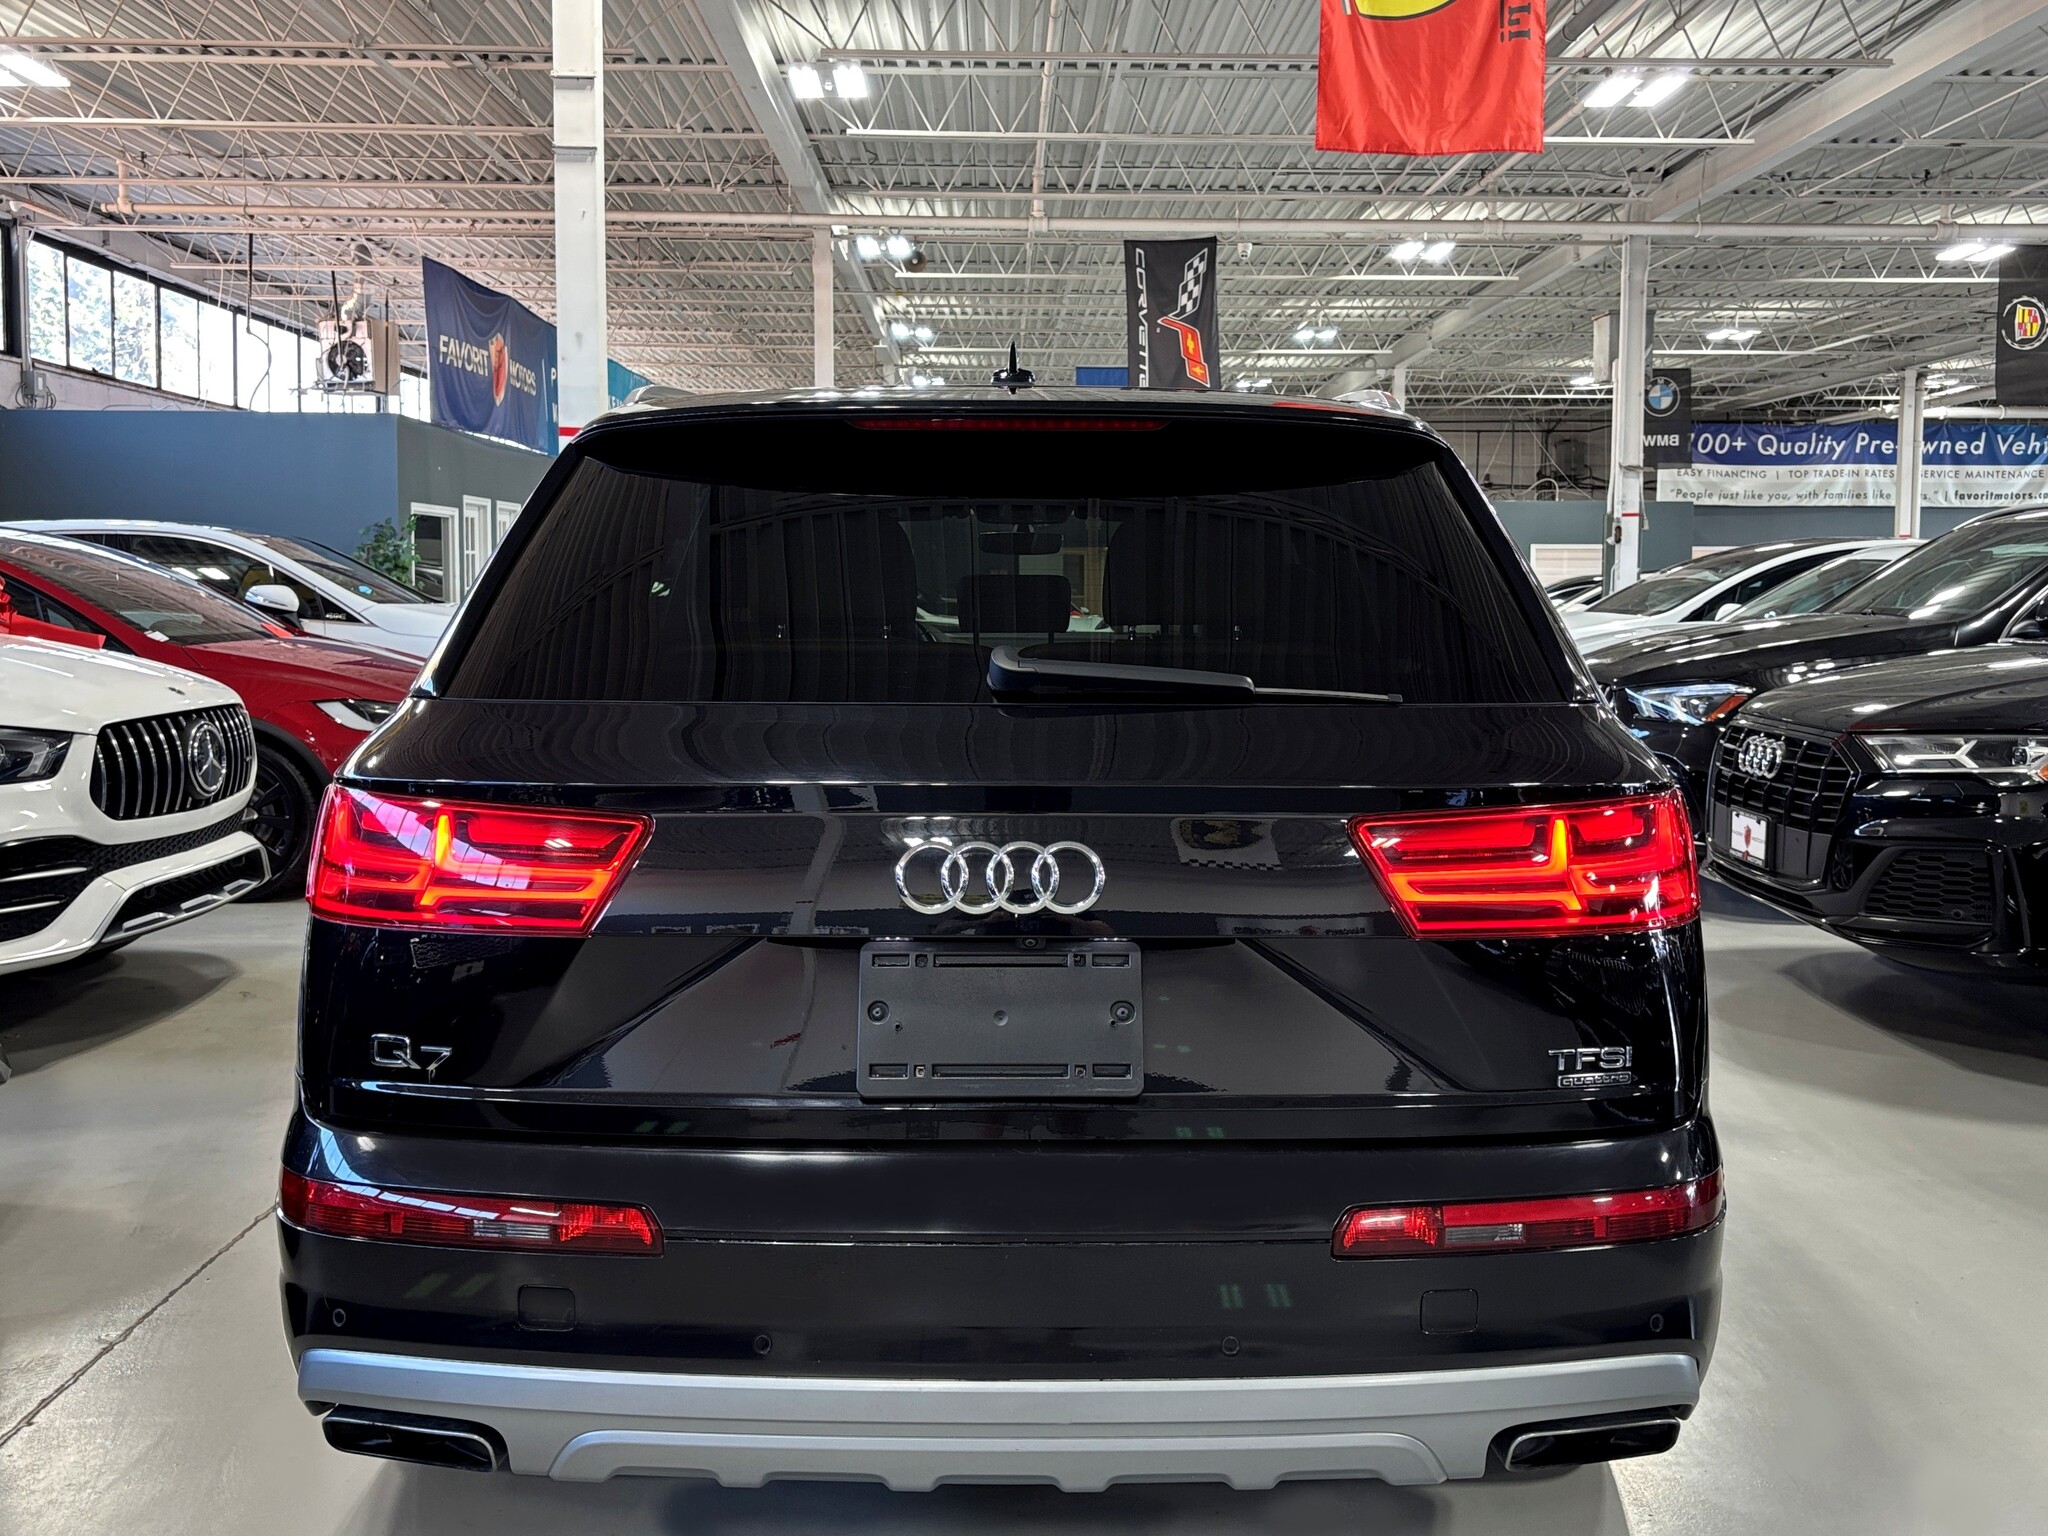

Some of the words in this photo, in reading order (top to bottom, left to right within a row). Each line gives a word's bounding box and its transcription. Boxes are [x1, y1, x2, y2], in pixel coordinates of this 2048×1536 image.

[1136, 247, 1149, 388] CORVETTE
[440, 334, 489, 377] FAVORIT
[509, 358, 537, 397] MOTORS
[1757, 432, 1846, 460] Quality
[1677, 468, 1704, 477] EASY
[1706, 469, 1767, 479] FINANCING
[1788, 469, 1809, 479] TOP
[1814, 469, 1860, 478] TRADE-IN
[1864, 469, 1895, 478] RATES
[1965, 469, 2045, 479] MAINTENANCE
[1718, 489, 1740, 501] just
[1743, 489, 1764, 500] like
[1768, 493, 1791, 503] you,
[1796, 489, 1819, 500] with
[1823, 489, 1868, 500] families
[1872, 489, 1892, 500] like
[371, 1032, 453, 1070] Q7
[1548, 1046, 1632, 1071] TFSI
[1562, 1075, 1629, 1087] quattro
